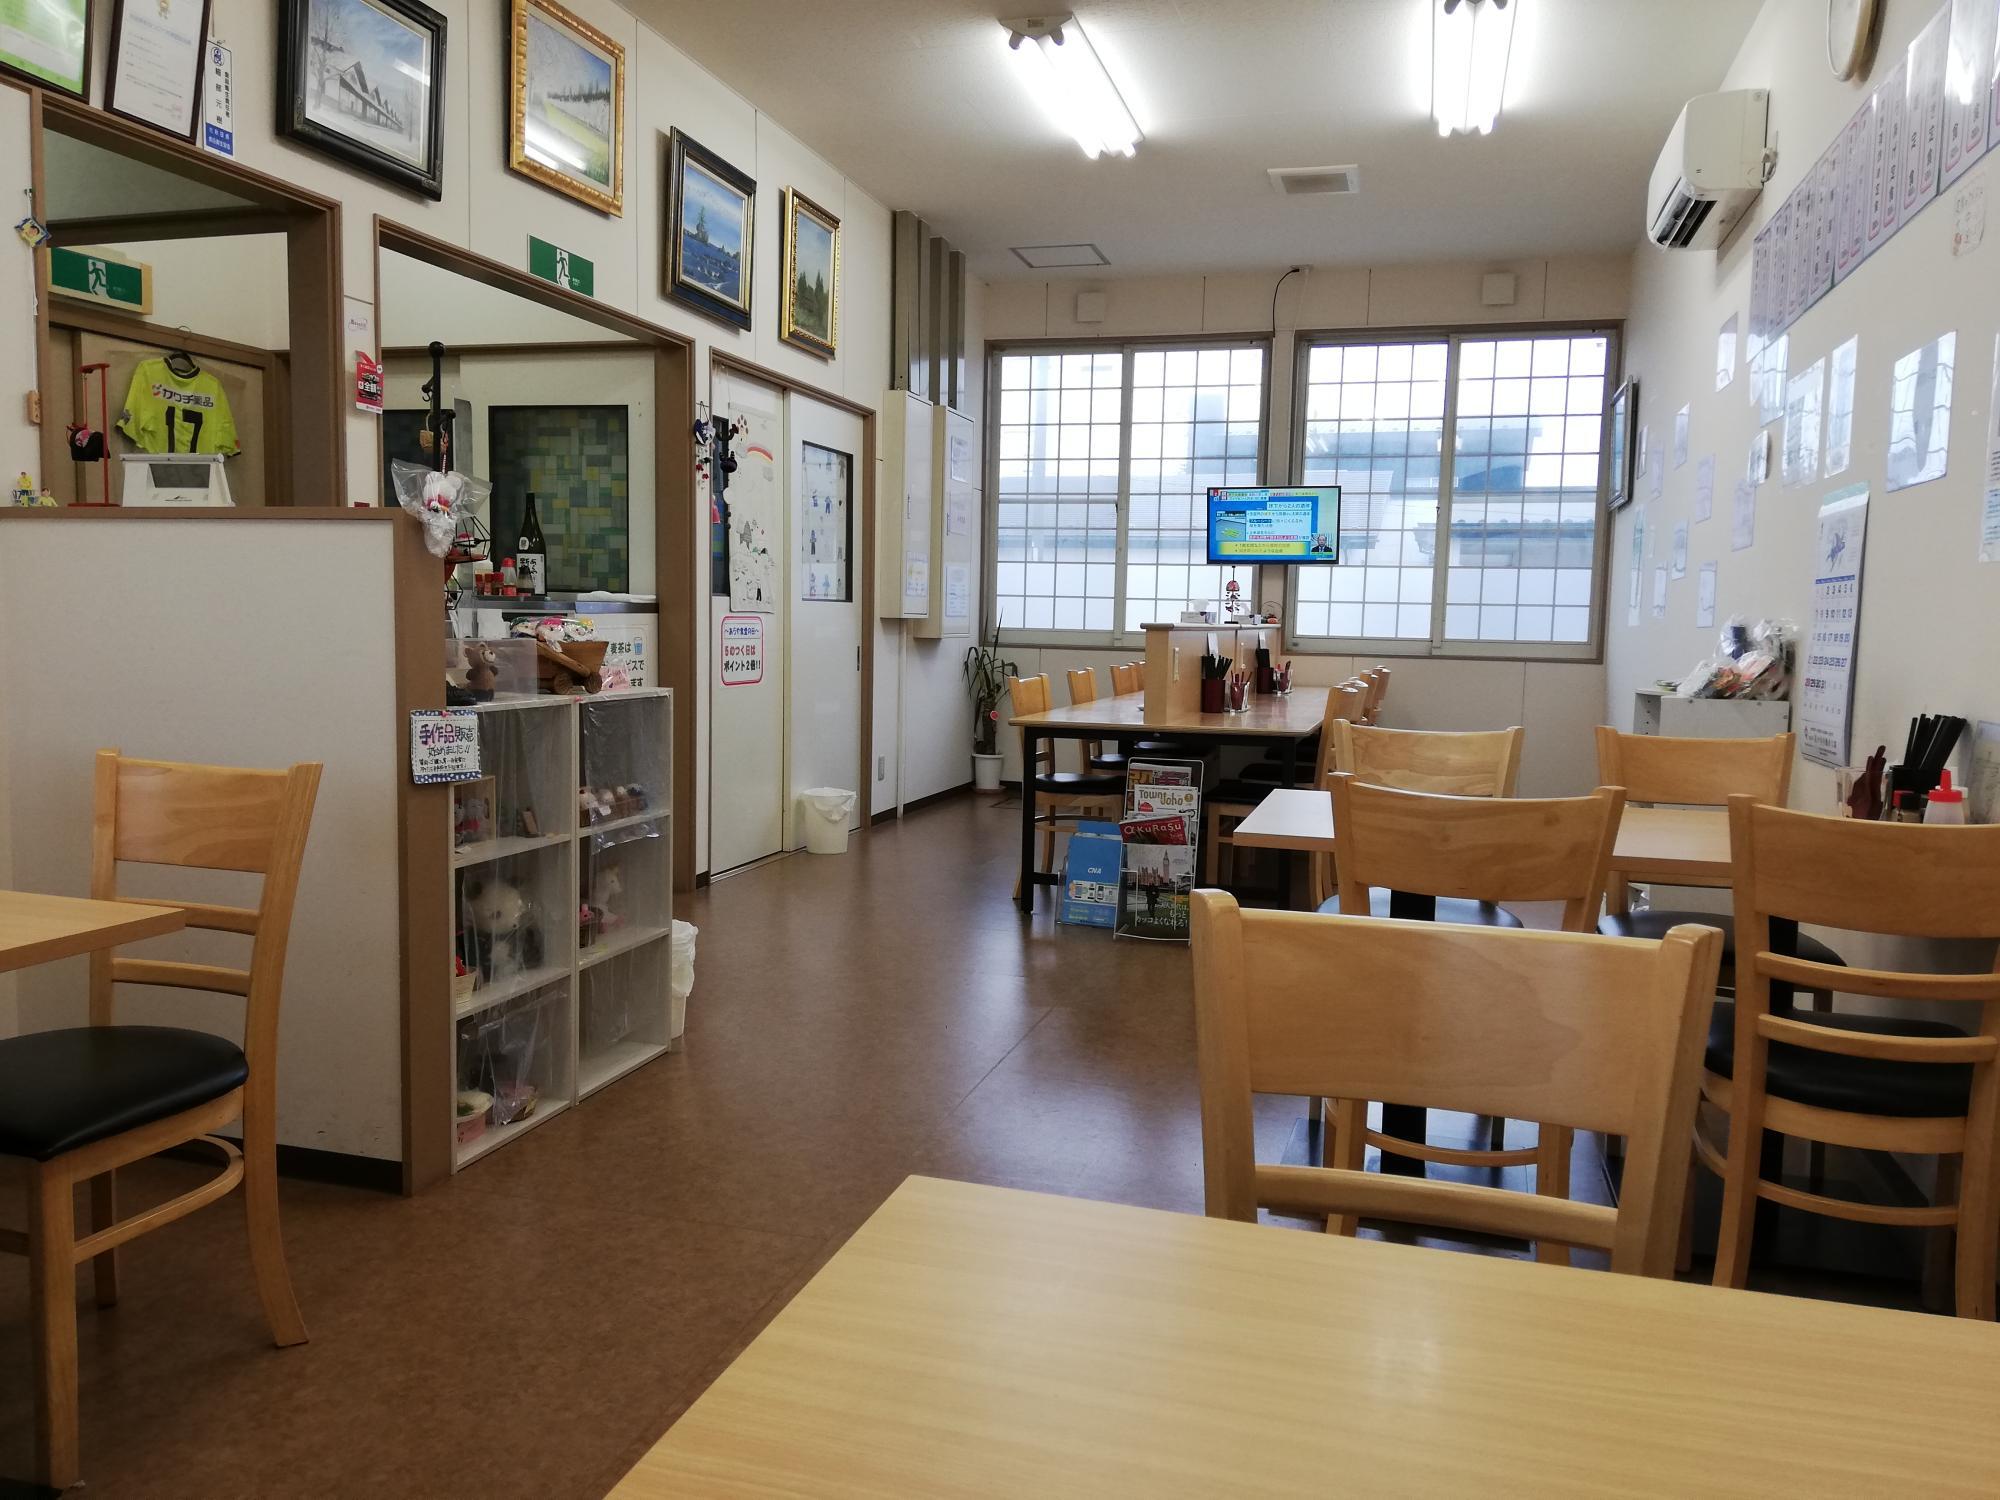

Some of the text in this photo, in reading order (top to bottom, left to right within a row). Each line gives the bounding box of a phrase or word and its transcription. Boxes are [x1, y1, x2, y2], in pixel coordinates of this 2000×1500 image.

[162, 388, 214, 408] カワチ薬品
[165, 405, 203, 453] 17
[610, 642, 632, 654] 麦茶は
[419, 722, 475, 746] 手作品販売
[1139, 789, 1164, 800] Town
